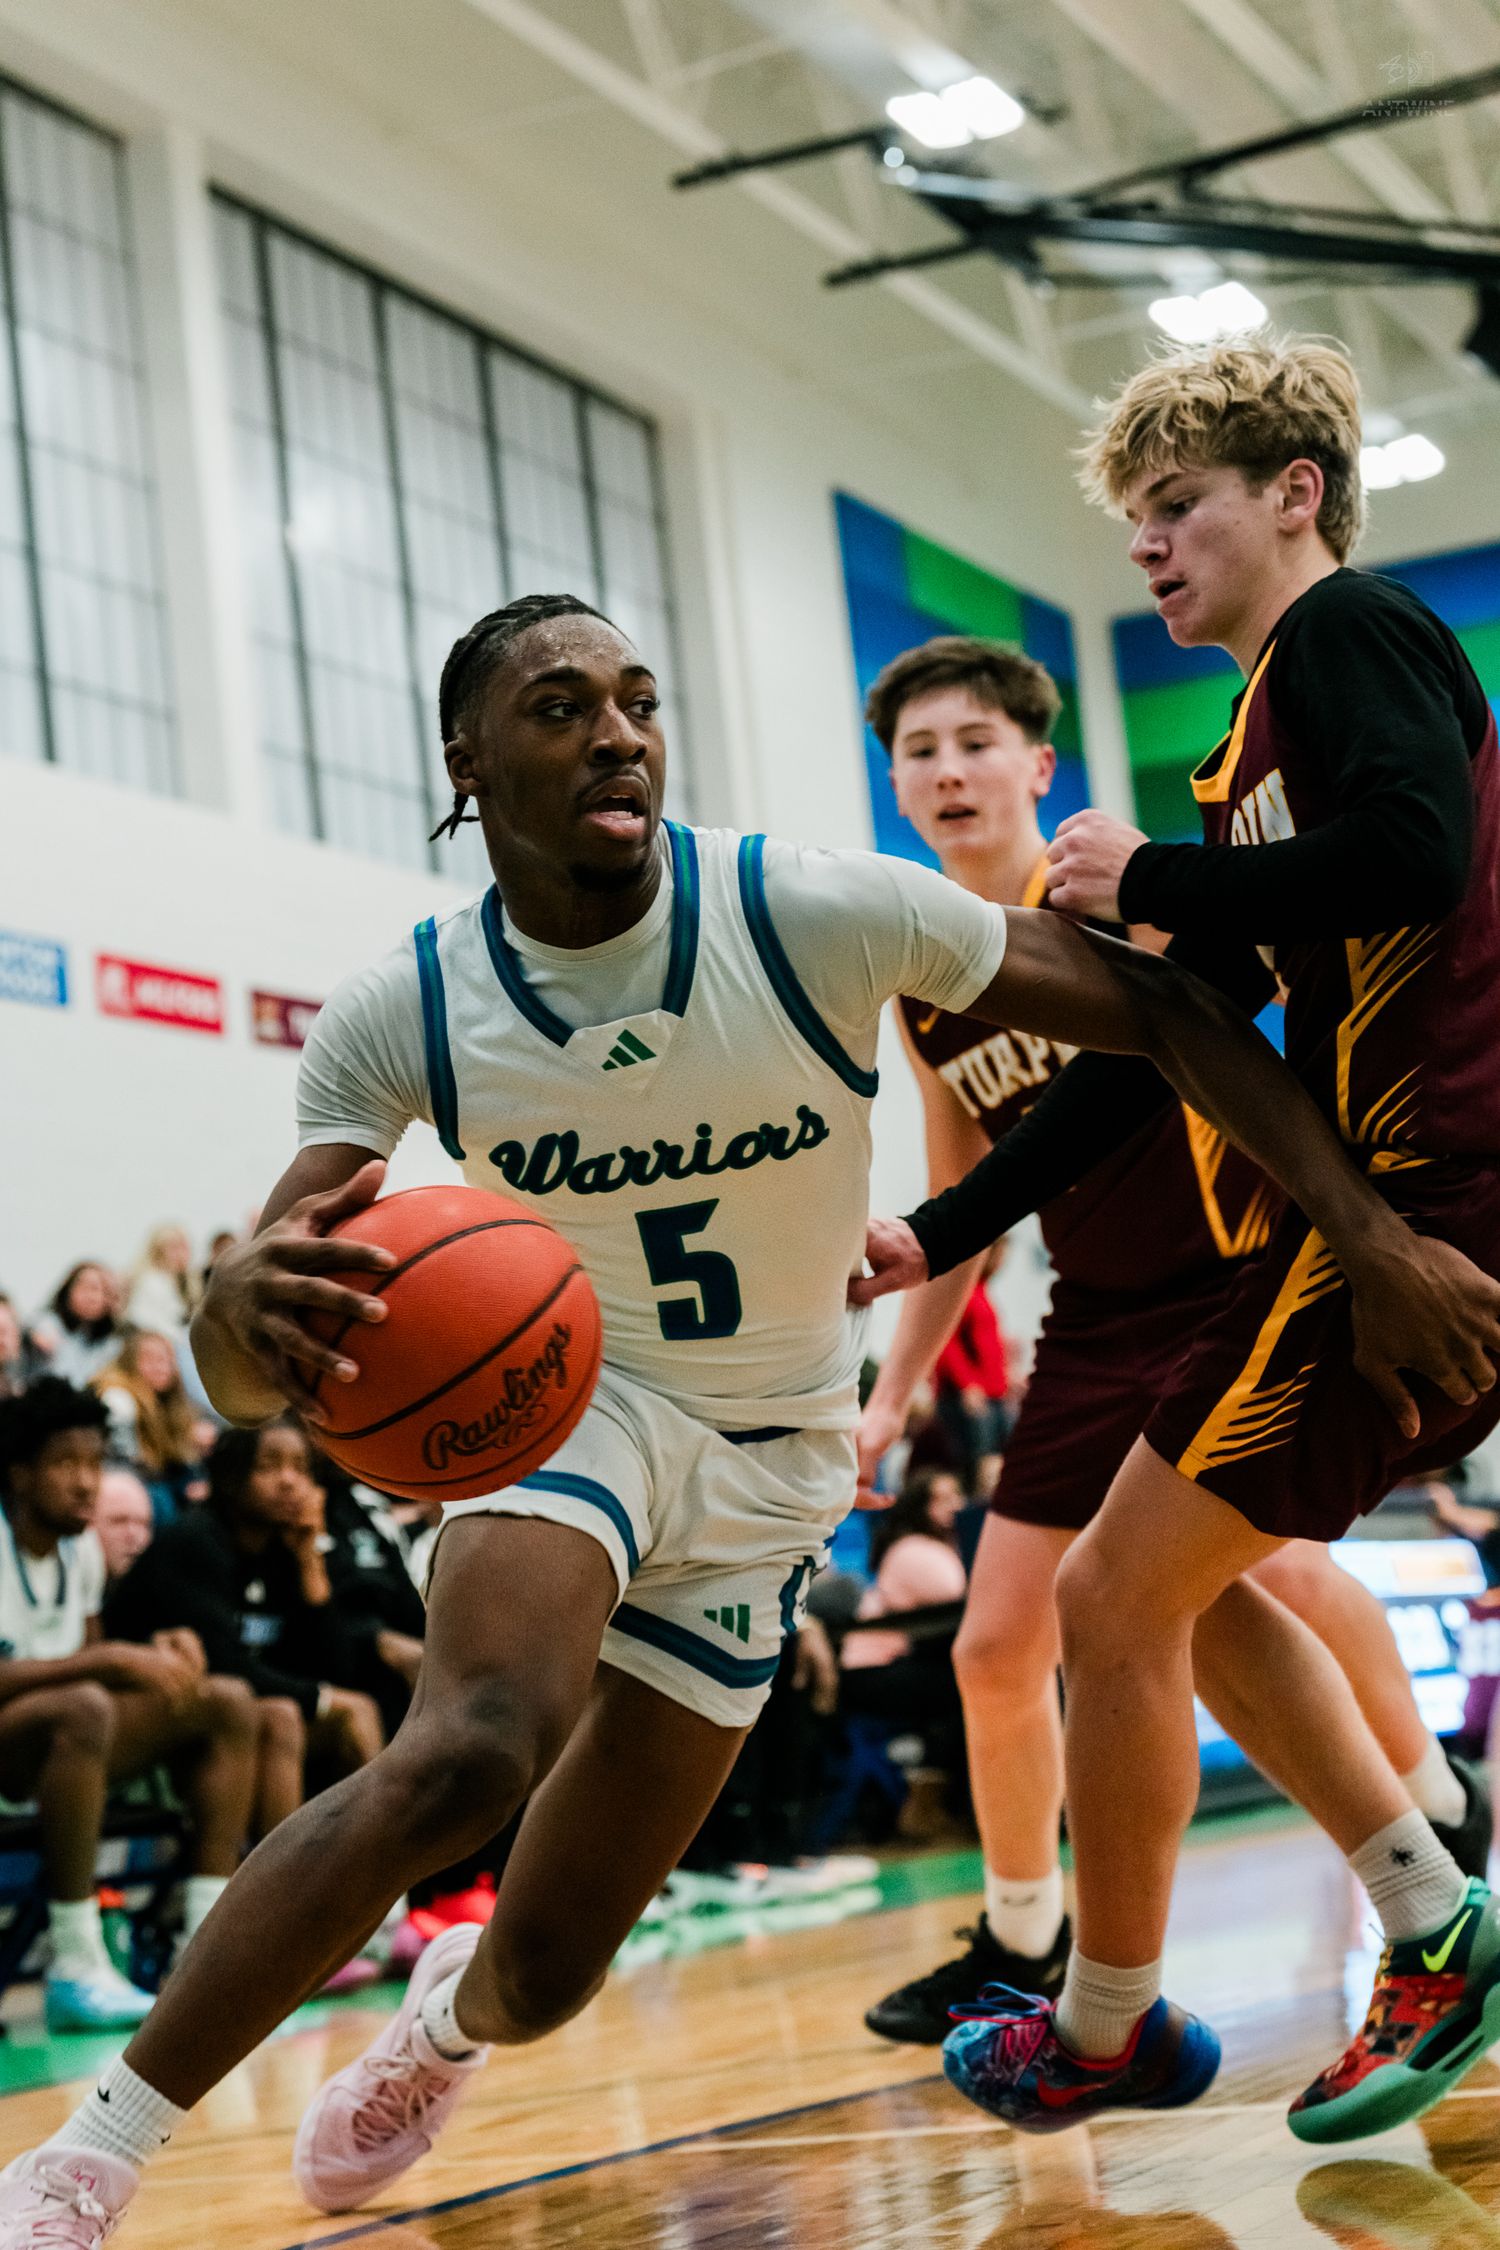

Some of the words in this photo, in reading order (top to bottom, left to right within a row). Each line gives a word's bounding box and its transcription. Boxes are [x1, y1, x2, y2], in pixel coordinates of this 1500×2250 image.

[489, 1104, 830, 1195] Warriors
[635, 1198, 742, 1341] 5
[422, 1323, 571, 1470] Rawlings
